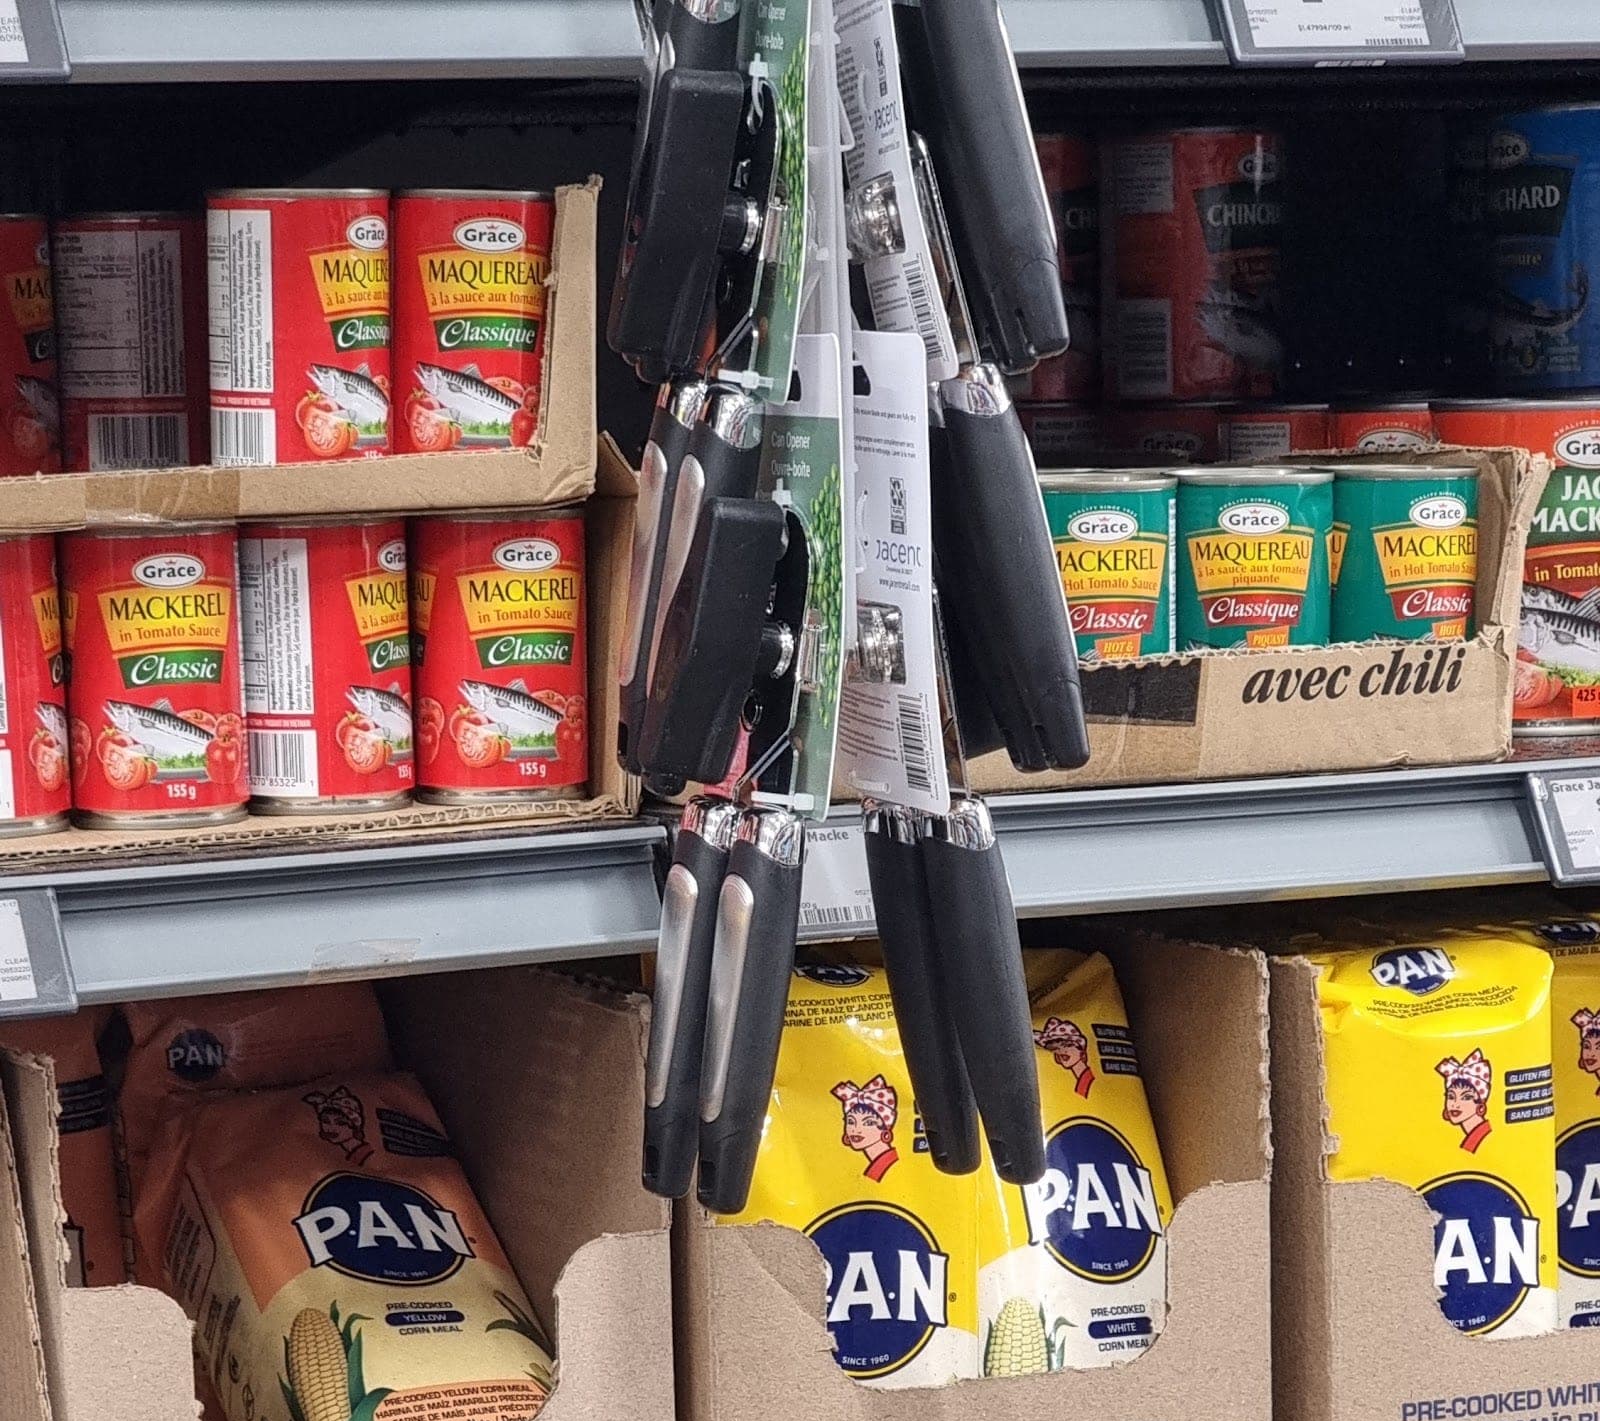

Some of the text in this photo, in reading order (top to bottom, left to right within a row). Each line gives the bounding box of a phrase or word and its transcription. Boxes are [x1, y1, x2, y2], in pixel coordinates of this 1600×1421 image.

[427, 259, 547, 288] MAQUEREAU
[441, 319, 535, 348] Classique
[786, 431, 811, 450] Opener
[502, 548, 552, 563] Grace
[1194, 541, 1310, 566] MAQUEREAU
[1205, 566, 1215, 576] la
[1218, 565, 1247, 576] sauce
[1250, 565, 1269, 573] aux
[1271, 565, 1307, 575] tomates
[1232, 574, 1280, 587] piquante
[468, 577, 577, 603] MACKEREL
[109, 592, 226, 622] MACKEREL
[478, 606, 573, 624] in Tomato Sauce
[1208, 598, 1299, 624] Classique
[119, 624, 221, 642] in Tomato Sauce
[1253, 633, 1287, 646] PIQUANT
[487, 636, 569, 664] Classic
[130, 655, 217, 685] Classic
[1242, 646, 1463, 704] avec chili
[1576, 688, 1596, 702] 425
[167, 784, 197, 800] 155 g
[807, 829, 849, 843] Macke
[1510, 1110, 1532, 1121] SANS
[1091, 1261, 1114, 1272] SINCE
[403, 1314, 447, 1322] YELLOW
[1090, 1303, 1146, 1318] PRE-COOKED
[1106, 1322, 1137, 1334] WHITE
[842, 1352, 890, 1367] SINCE 1960
[375, 1407, 413, 1420] HARINA
[414, 1405, 426, 1413] DE
[453, 1396, 499, 1408] AMARILLO
[428, 1413, 440, 1421] DE
[468, 1406, 497, 1417] JAUNE
